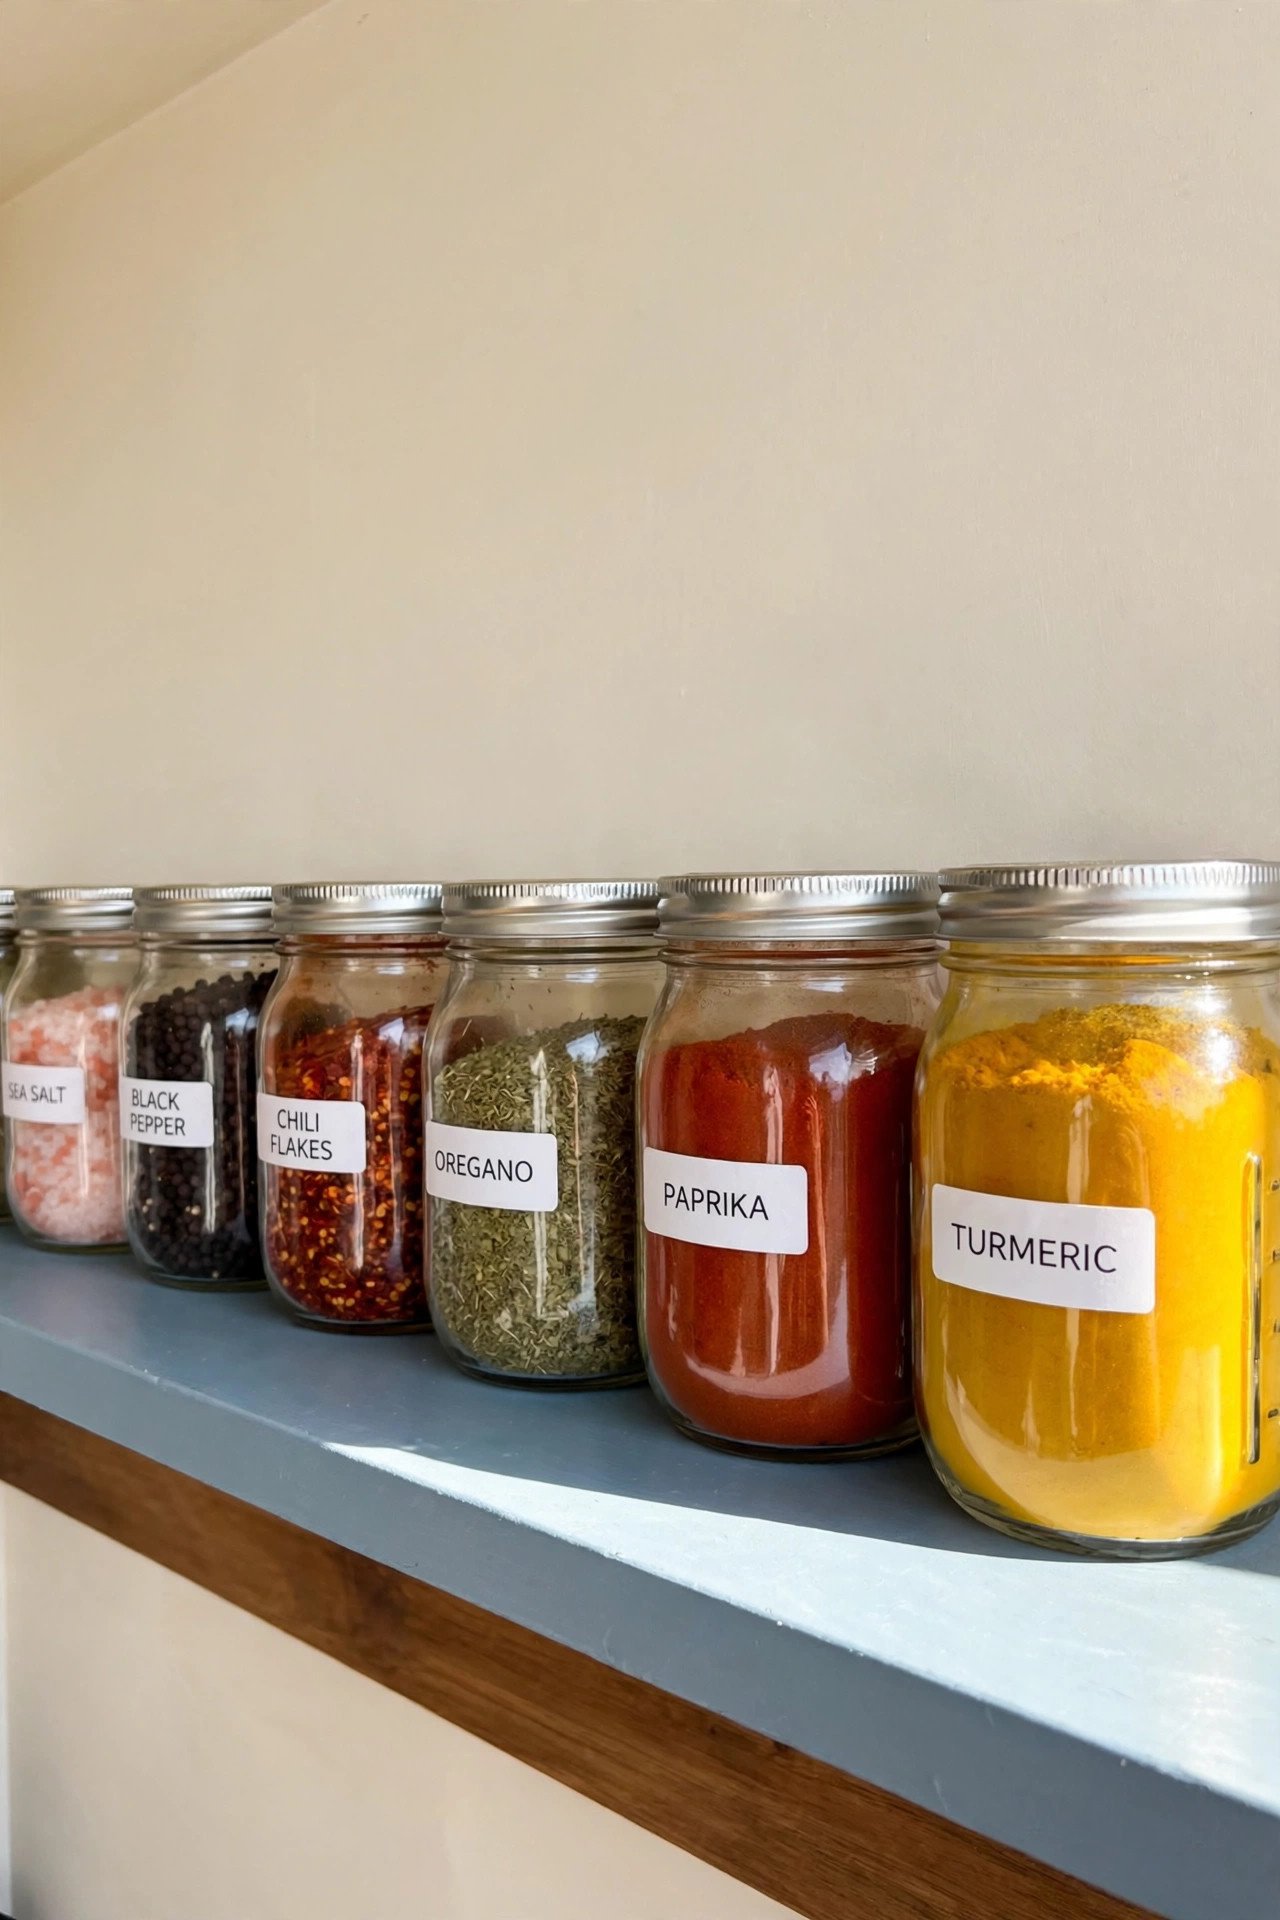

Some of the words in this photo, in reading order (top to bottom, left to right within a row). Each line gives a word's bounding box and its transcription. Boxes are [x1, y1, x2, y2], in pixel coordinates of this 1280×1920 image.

[9, 1082, 28, 1101] SEA
[31, 1085, 67, 1104] SALT
[131, 1088, 180, 1111] BLACK
[130, 1112, 185, 1136] PEPPER
[277, 1109, 320, 1133] CHILI
[270, 1134, 333, 1161] FLAKES
[434, 1149, 533, 1183] OREGANO
[664, 1182, 769, 1221] PAPRIKA
[950, 1222, 1117, 1274] TURMERIC
